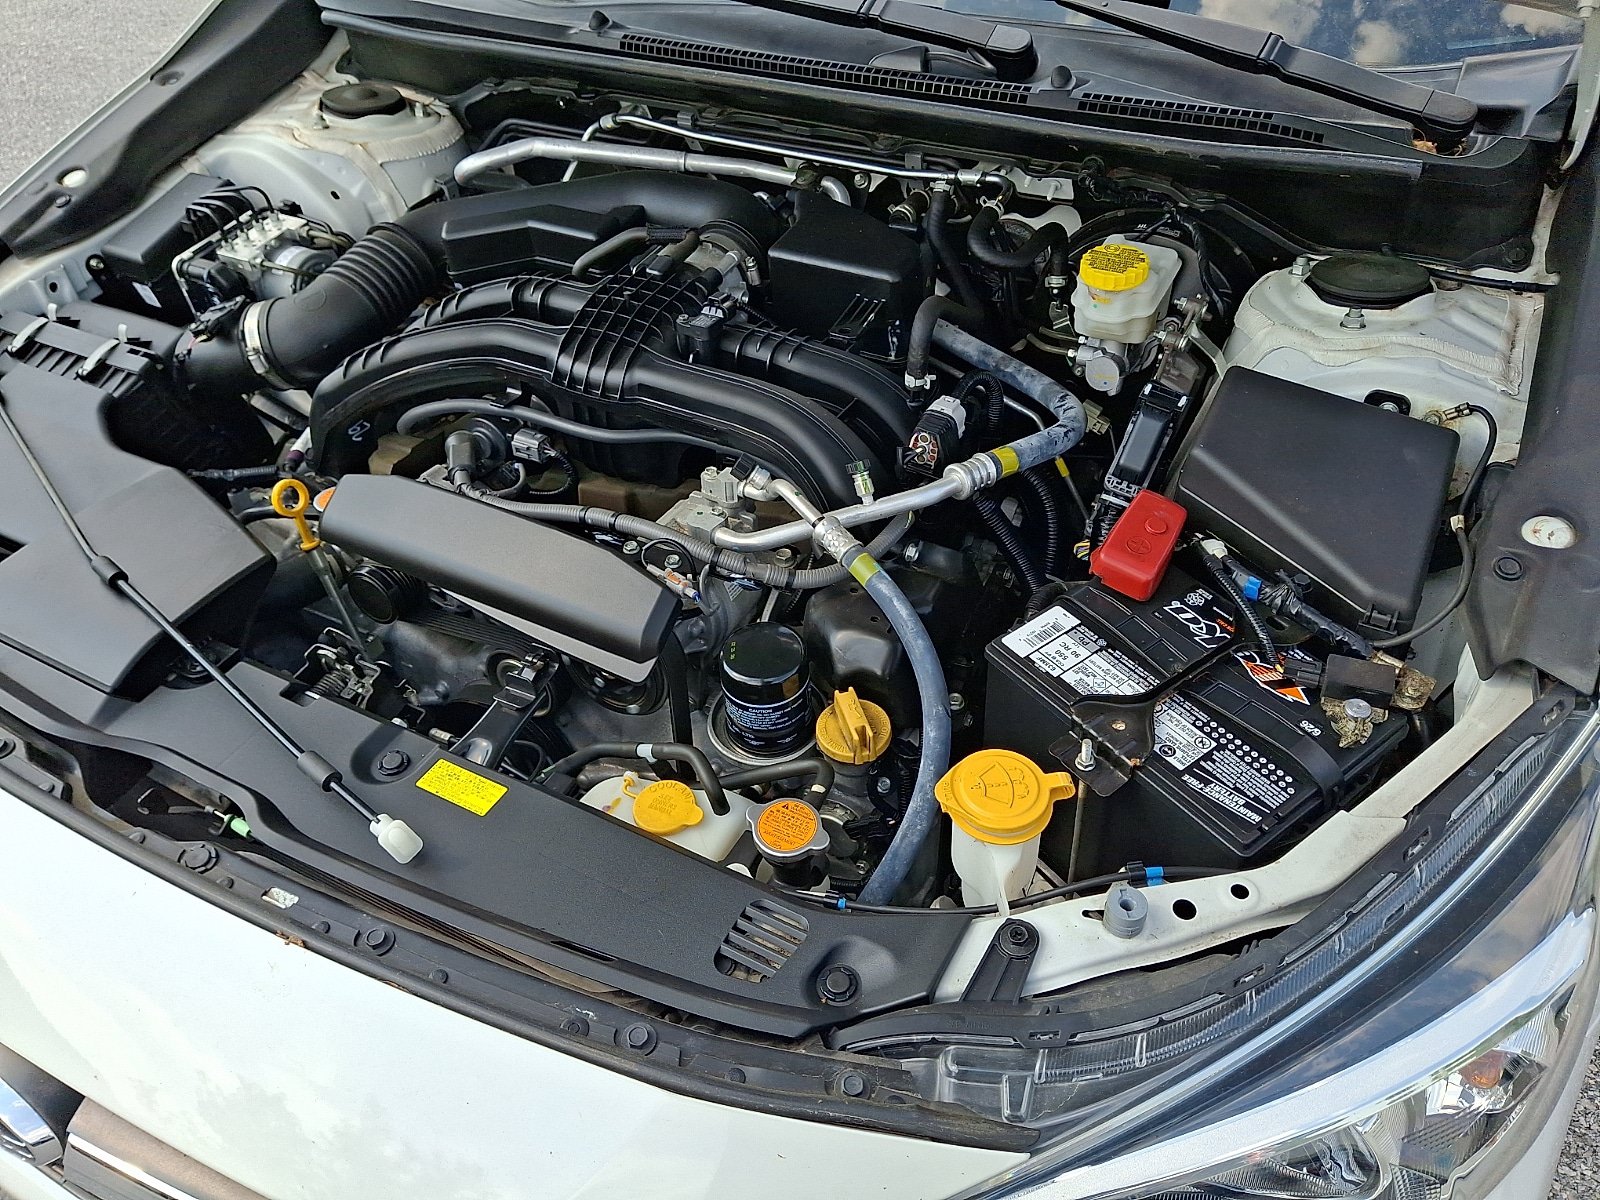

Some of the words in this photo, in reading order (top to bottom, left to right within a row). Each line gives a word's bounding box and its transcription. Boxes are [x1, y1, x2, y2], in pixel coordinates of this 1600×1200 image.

[1058, 640, 1072, 651] RC
[1076, 635, 1090, 646] Pb
[1053, 648, 1069, 661] 550
[1069, 649, 1081, 659] 90
[1298, 718, 1322, 737] 6/26
[649, 781, 695, 805] COOLANT
[1180, 773, 1262, 823] MAINTENANCE-FREE
[1207, 781, 1246, 805] BATTERY
